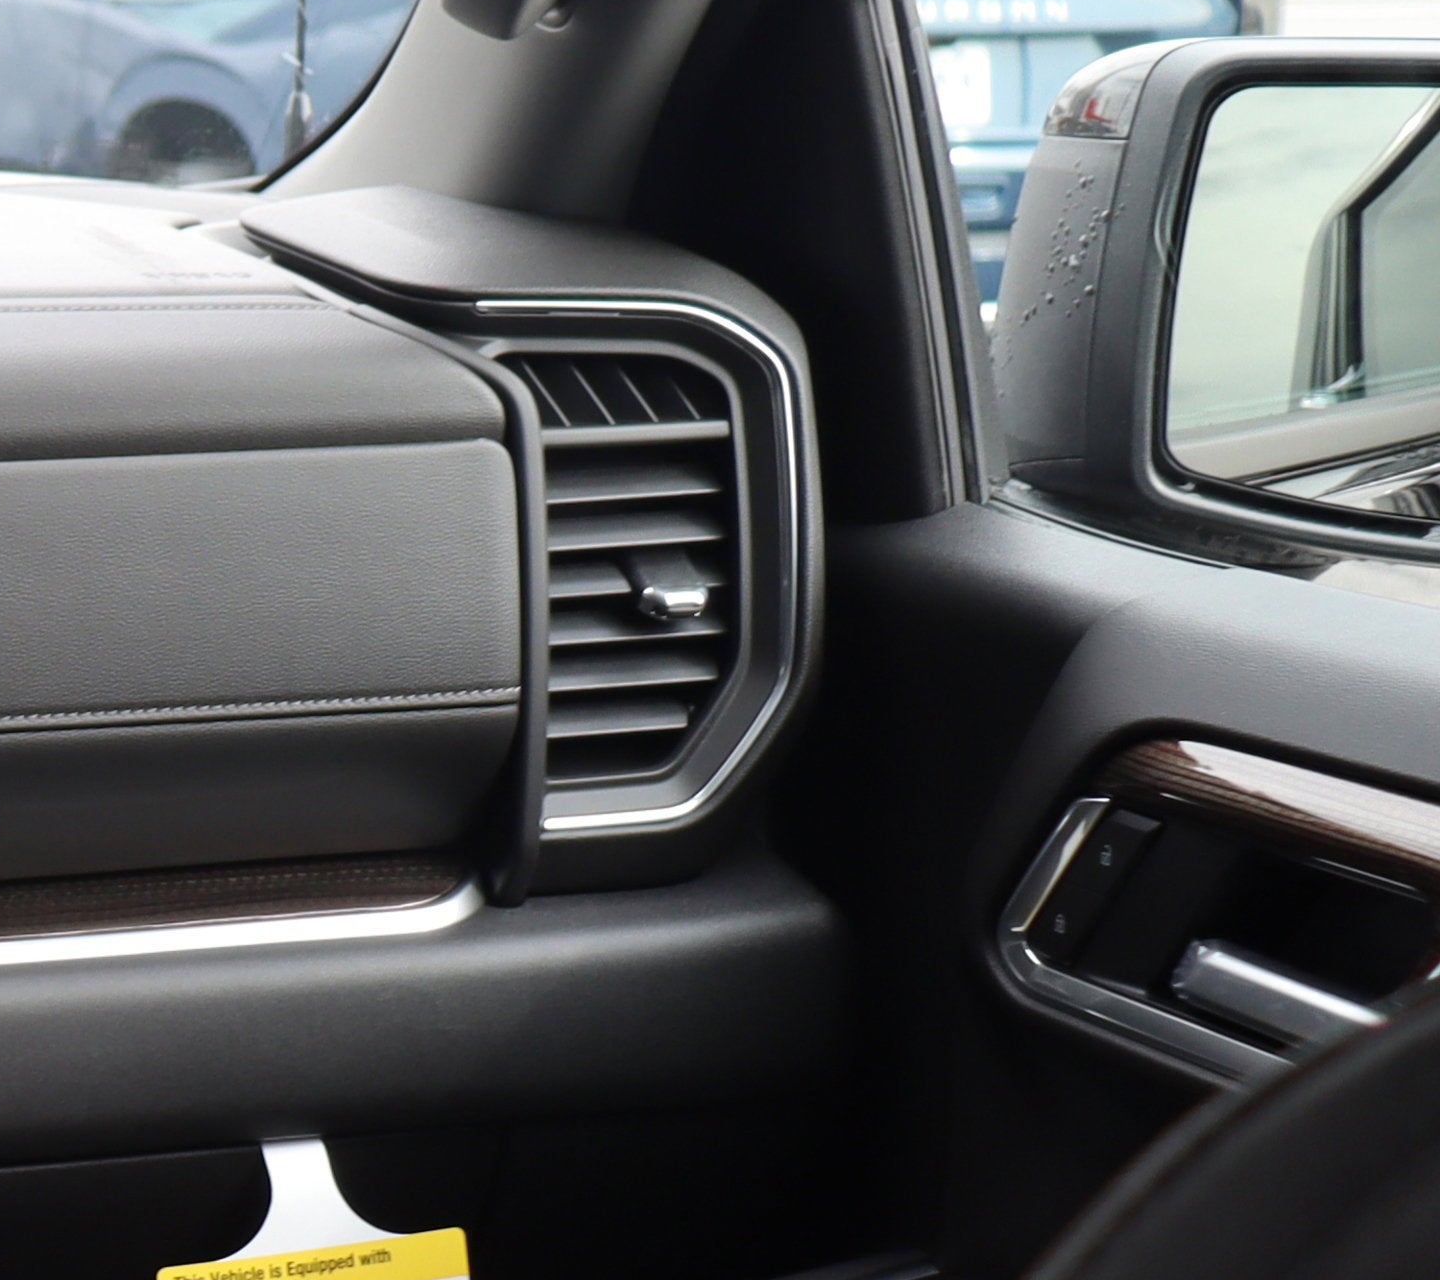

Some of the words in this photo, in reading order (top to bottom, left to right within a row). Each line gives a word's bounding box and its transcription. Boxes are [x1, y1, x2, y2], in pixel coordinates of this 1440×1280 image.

[270, 1264, 282, 1279] is
[288, 1254, 354, 1279] Equipped
[360, 1249, 390, 1266] with
